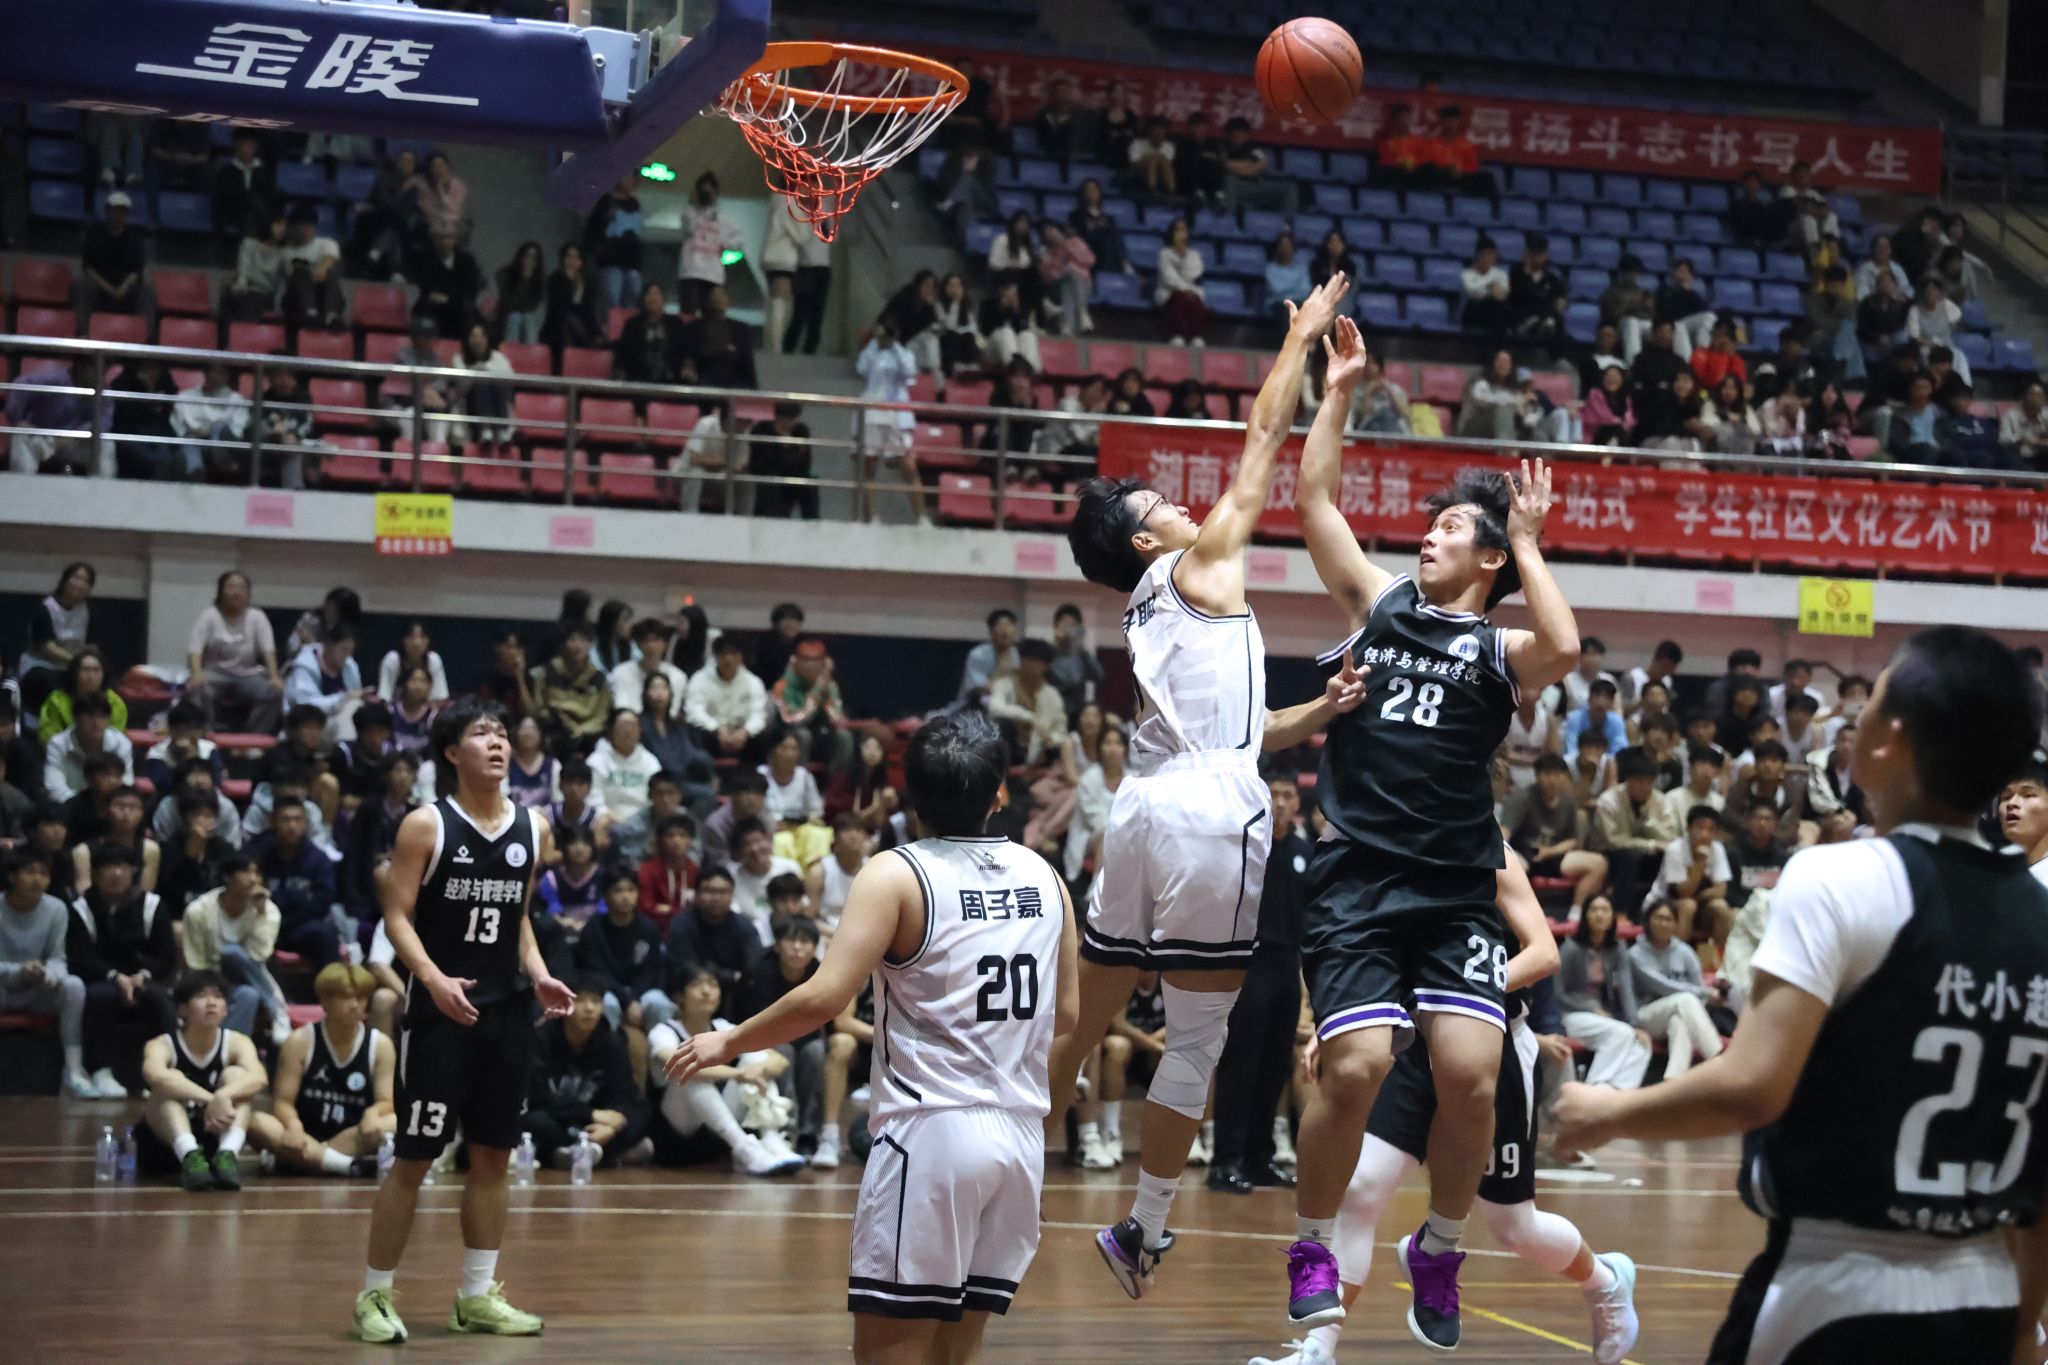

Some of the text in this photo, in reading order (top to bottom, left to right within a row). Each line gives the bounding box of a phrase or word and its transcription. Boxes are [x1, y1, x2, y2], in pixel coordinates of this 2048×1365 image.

[135, 22, 480, 106] 金陵
[1675, 481, 1996, 554] 学生社区文化艺术节
[1363, 645, 1482, 686] 经济与管理学院
[1379, 676, 1445, 728] 28
[463, 906, 501, 944] 13
[958, 886, 1044, 922] 周子豪
[976, 953, 1039, 1022] 20
[1463, 934, 1508, 992] 28
[405, 1099, 448, 1138] 13
[1894, 1026, 2048, 1197] 23
